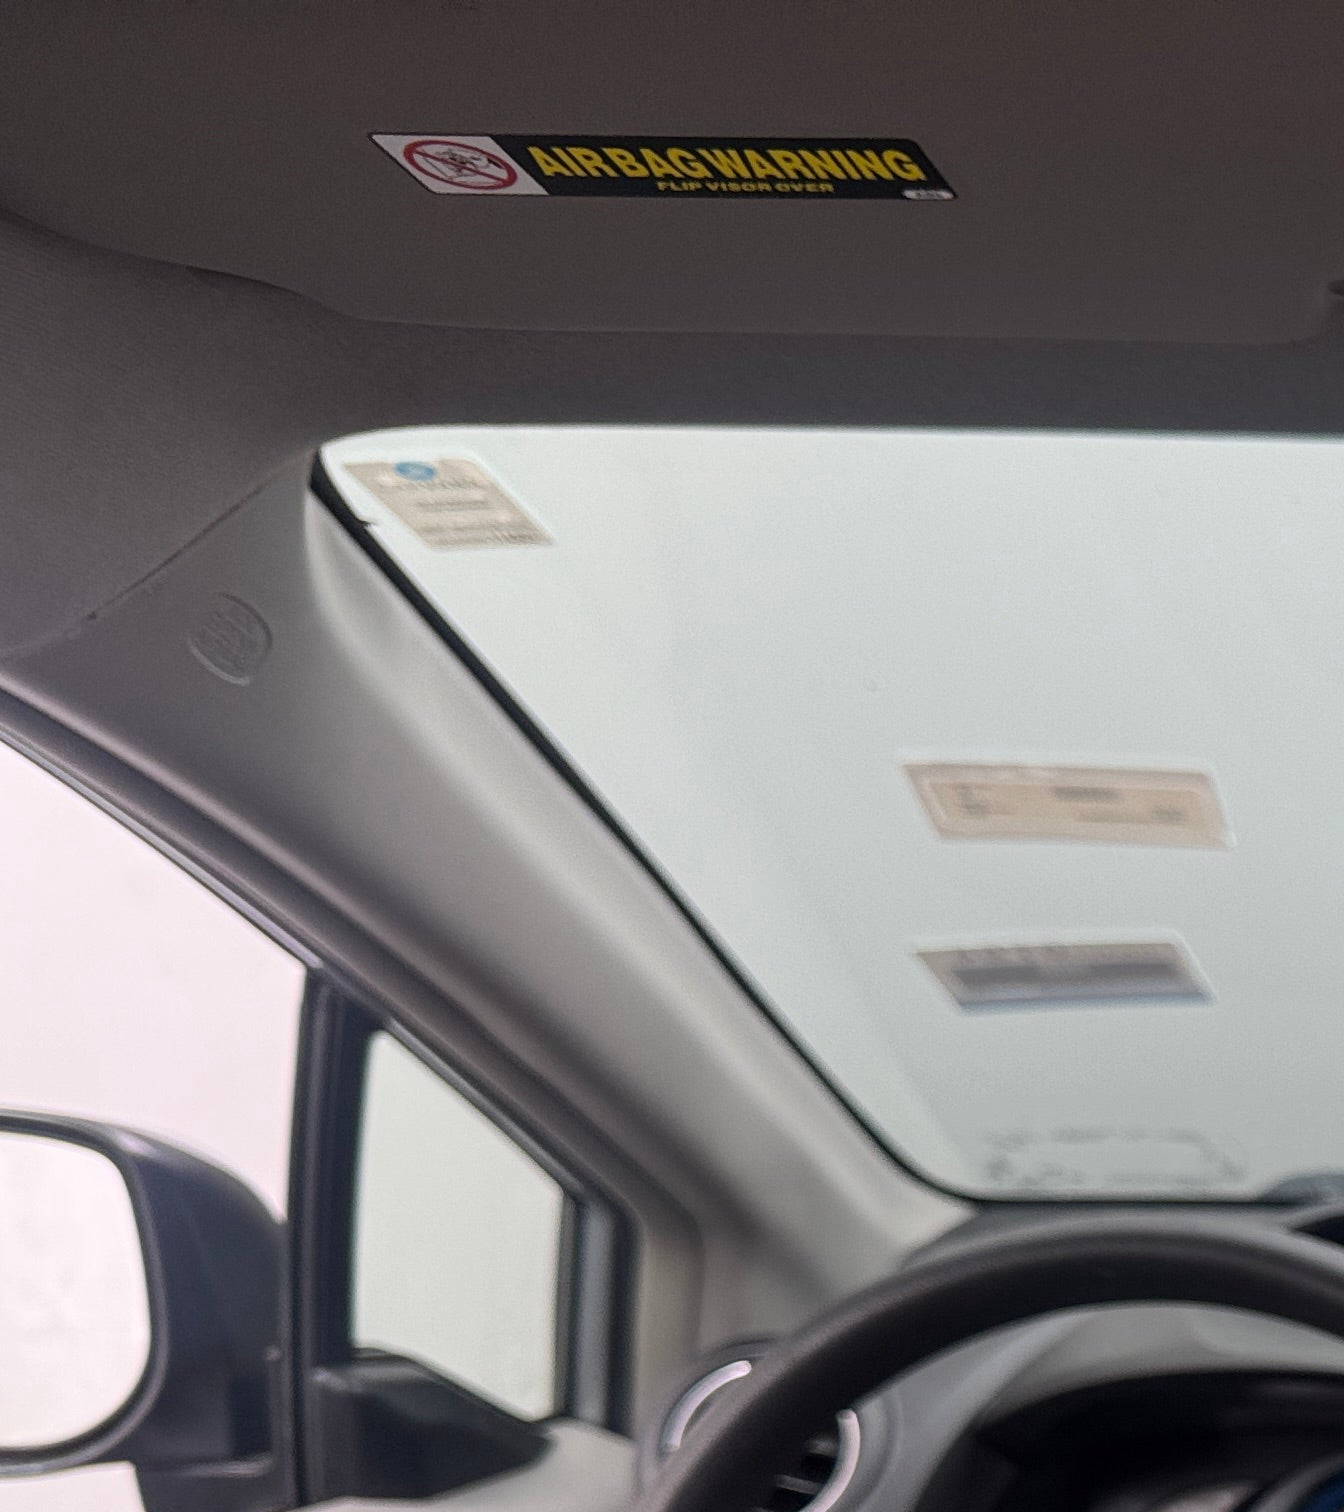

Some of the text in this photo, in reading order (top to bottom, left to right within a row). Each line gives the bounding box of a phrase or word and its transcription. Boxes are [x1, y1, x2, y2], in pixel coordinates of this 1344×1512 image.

[527, 146, 927, 181] AIRBAG WARNING
[657, 181, 835, 193] FLIP VISOR OVER
